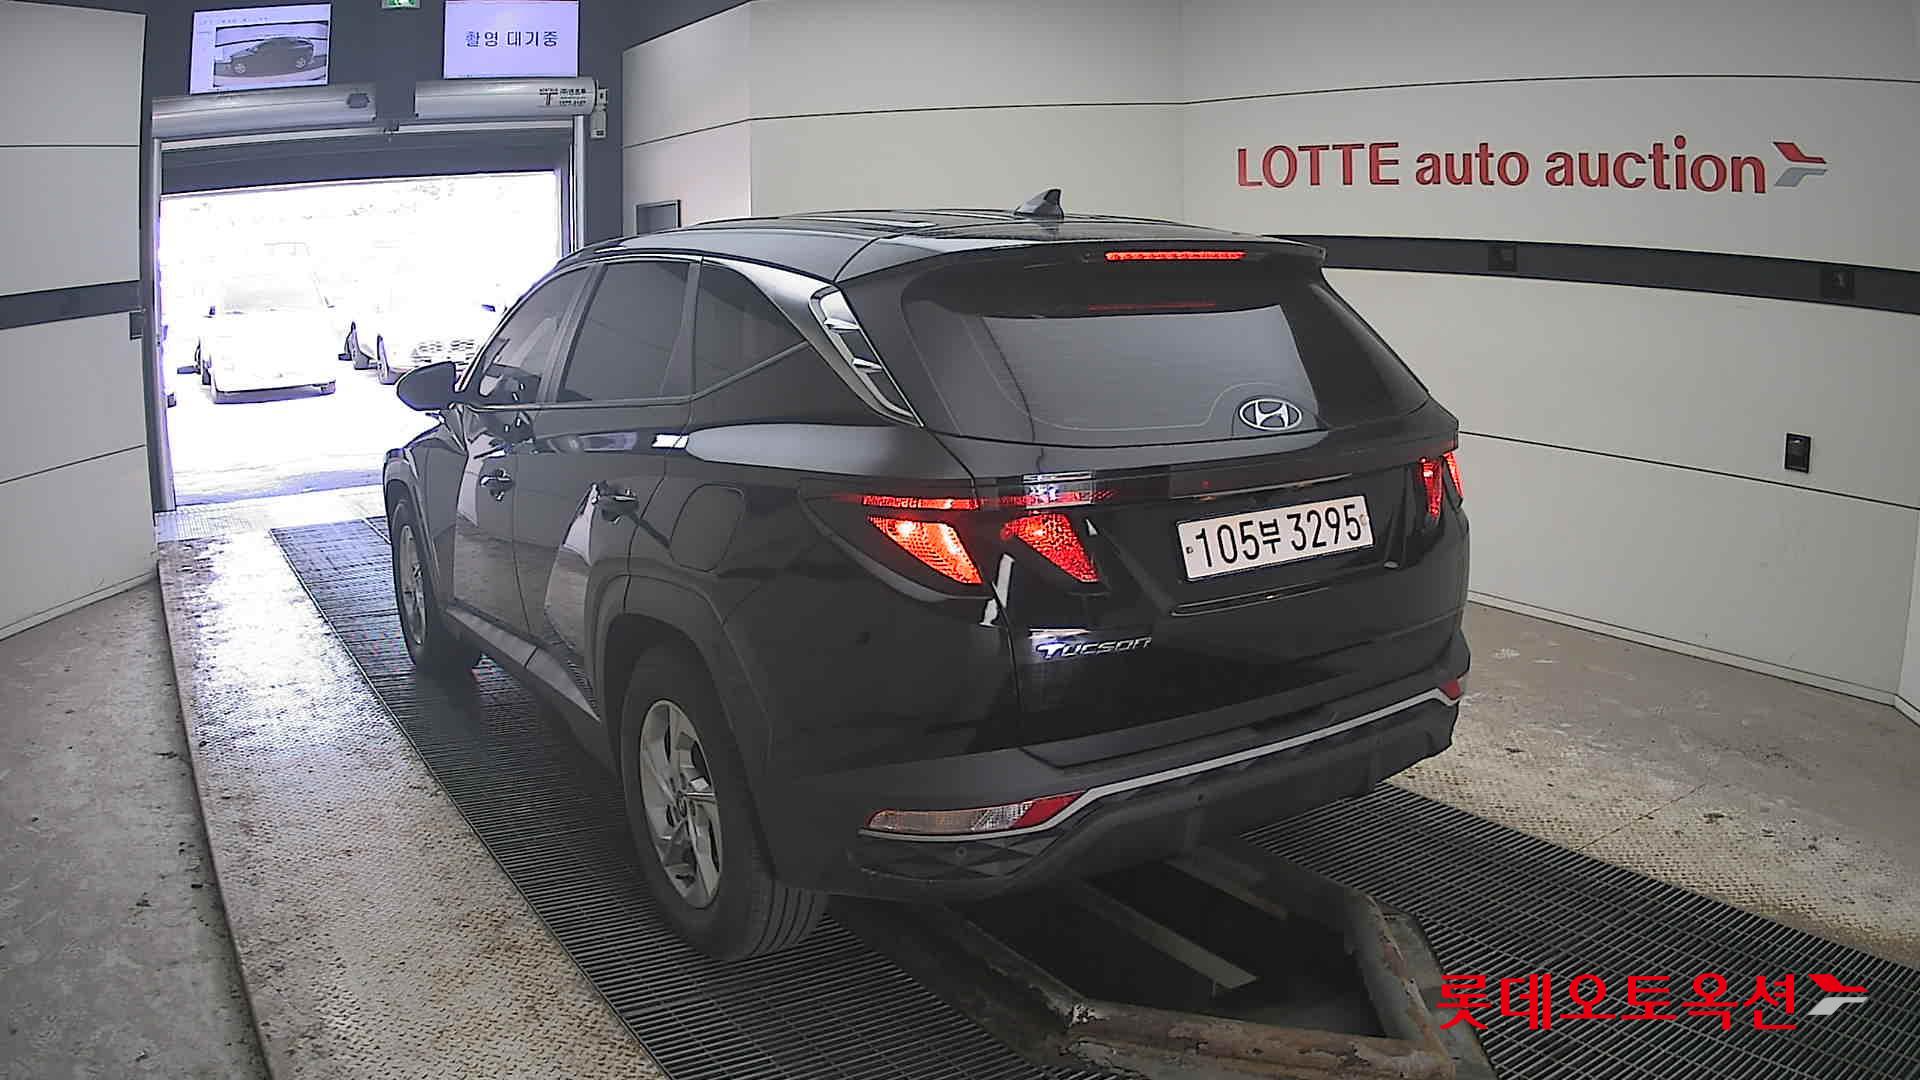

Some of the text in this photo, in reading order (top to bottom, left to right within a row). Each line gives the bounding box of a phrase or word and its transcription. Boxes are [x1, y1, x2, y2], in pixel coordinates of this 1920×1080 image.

[507, 31, 558, 47] 대기중
[1237, 135, 1767, 194] LOTTE auto auction
[1195, 504, 1362, 568] 105부 3295
